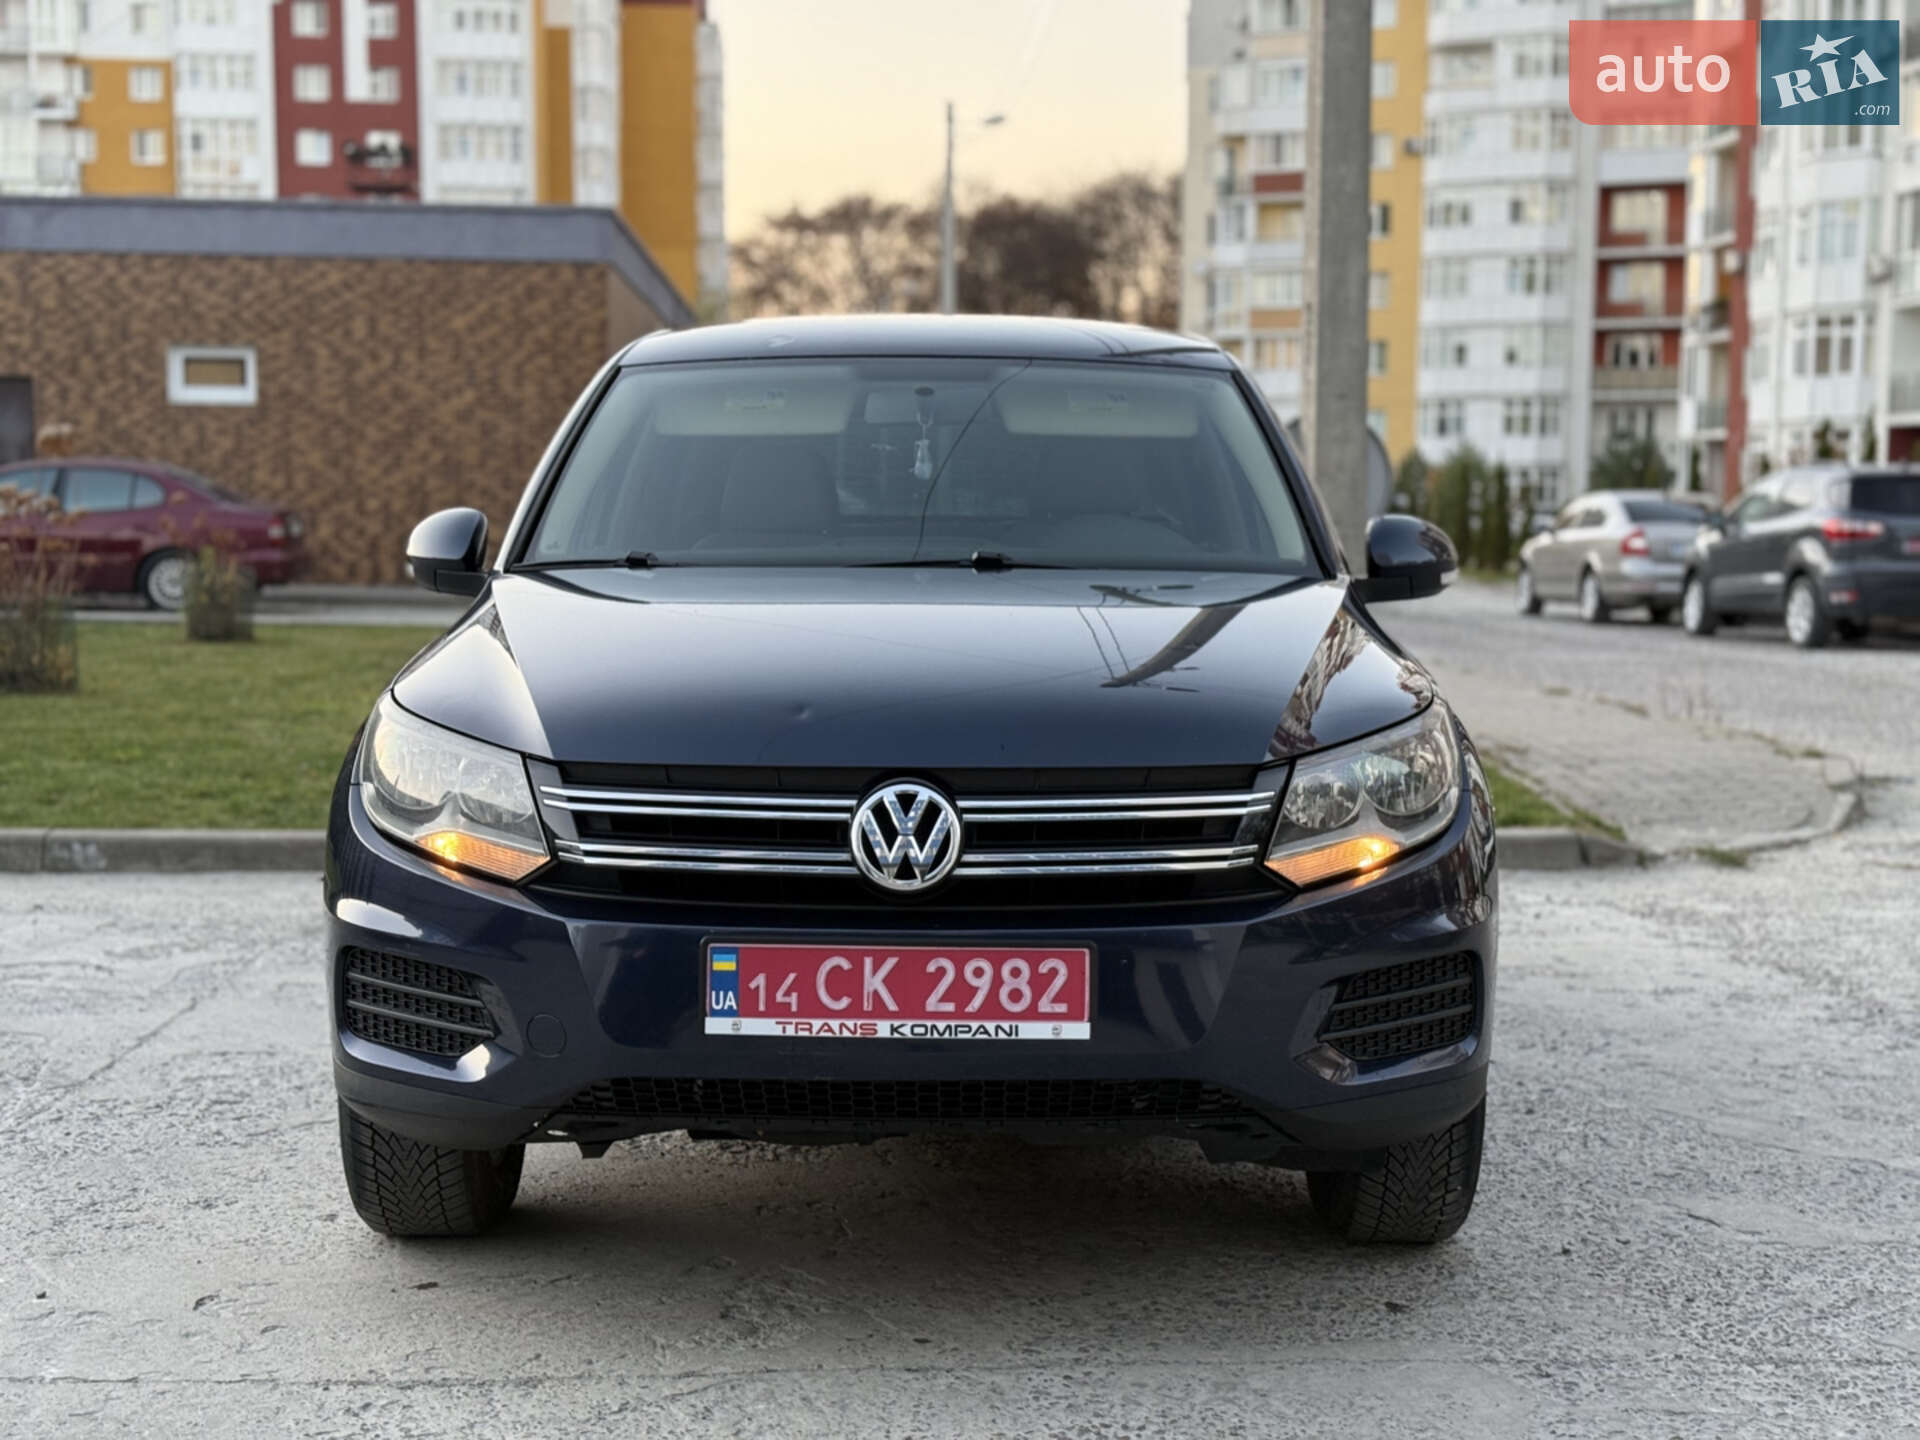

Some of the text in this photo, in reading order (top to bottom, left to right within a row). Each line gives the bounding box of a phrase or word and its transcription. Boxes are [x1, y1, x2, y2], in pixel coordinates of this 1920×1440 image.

[748, 955, 1069, 1013] 14 CK 2982
[711, 990, 738, 1010] UA
[775, 1020, 1020, 1038] TRANS KOMPANI
